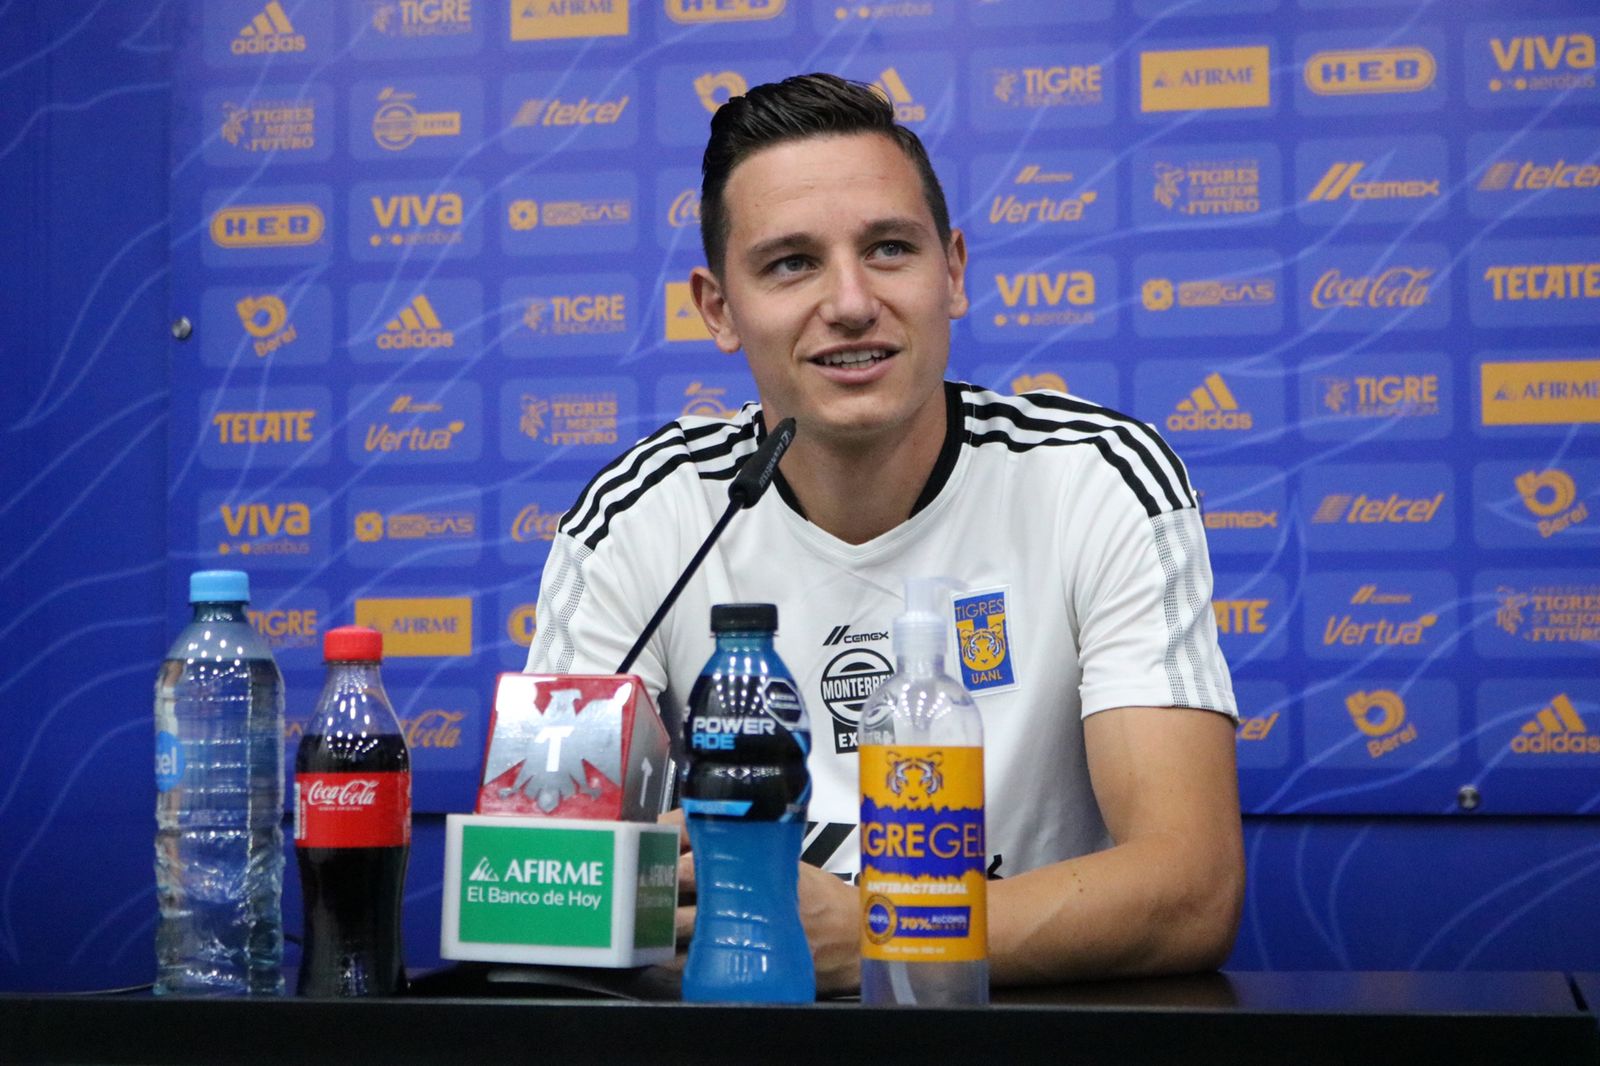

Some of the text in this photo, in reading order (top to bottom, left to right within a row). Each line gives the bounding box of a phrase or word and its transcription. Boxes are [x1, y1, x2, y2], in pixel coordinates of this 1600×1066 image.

[231, 35, 305, 54] adidas
[1023, 65, 1102, 96] TIGRE
[1180, 66, 1255, 87] AFIRME
[543, 96, 630, 126] telcel
[1514, 160, 1600, 190] telce
[989, 195, 1084, 223] Vertua
[1484, 263, 1600, 300] TECATE
[551, 293, 625, 322] TIGRE
[376, 331, 454, 350] adidas
[1355, 375, 1438, 404] TIGRE
[213, 410, 316, 444] TECATE
[1166, 412, 1253, 431] adidas
[364, 423, 452, 452] Vertua
[1204, 511, 1278, 529] EMEX
[1347, 493, 1445, 523] telcel
[954, 598, 1005, 620] TIGRES
[1212, 600, 1269, 634] ATE
[843, 631, 889, 644] CEMEX
[1323, 615, 1423, 645] Vertua
[971, 669, 1004, 685] UANL
[692, 715, 777, 736] POWER
[692, 733, 736, 750] ADE
[1510, 735, 1600, 753] adidas
[503, 858, 604, 886] AFIRME
[467, 885, 602, 911] El Banco de Hoy
